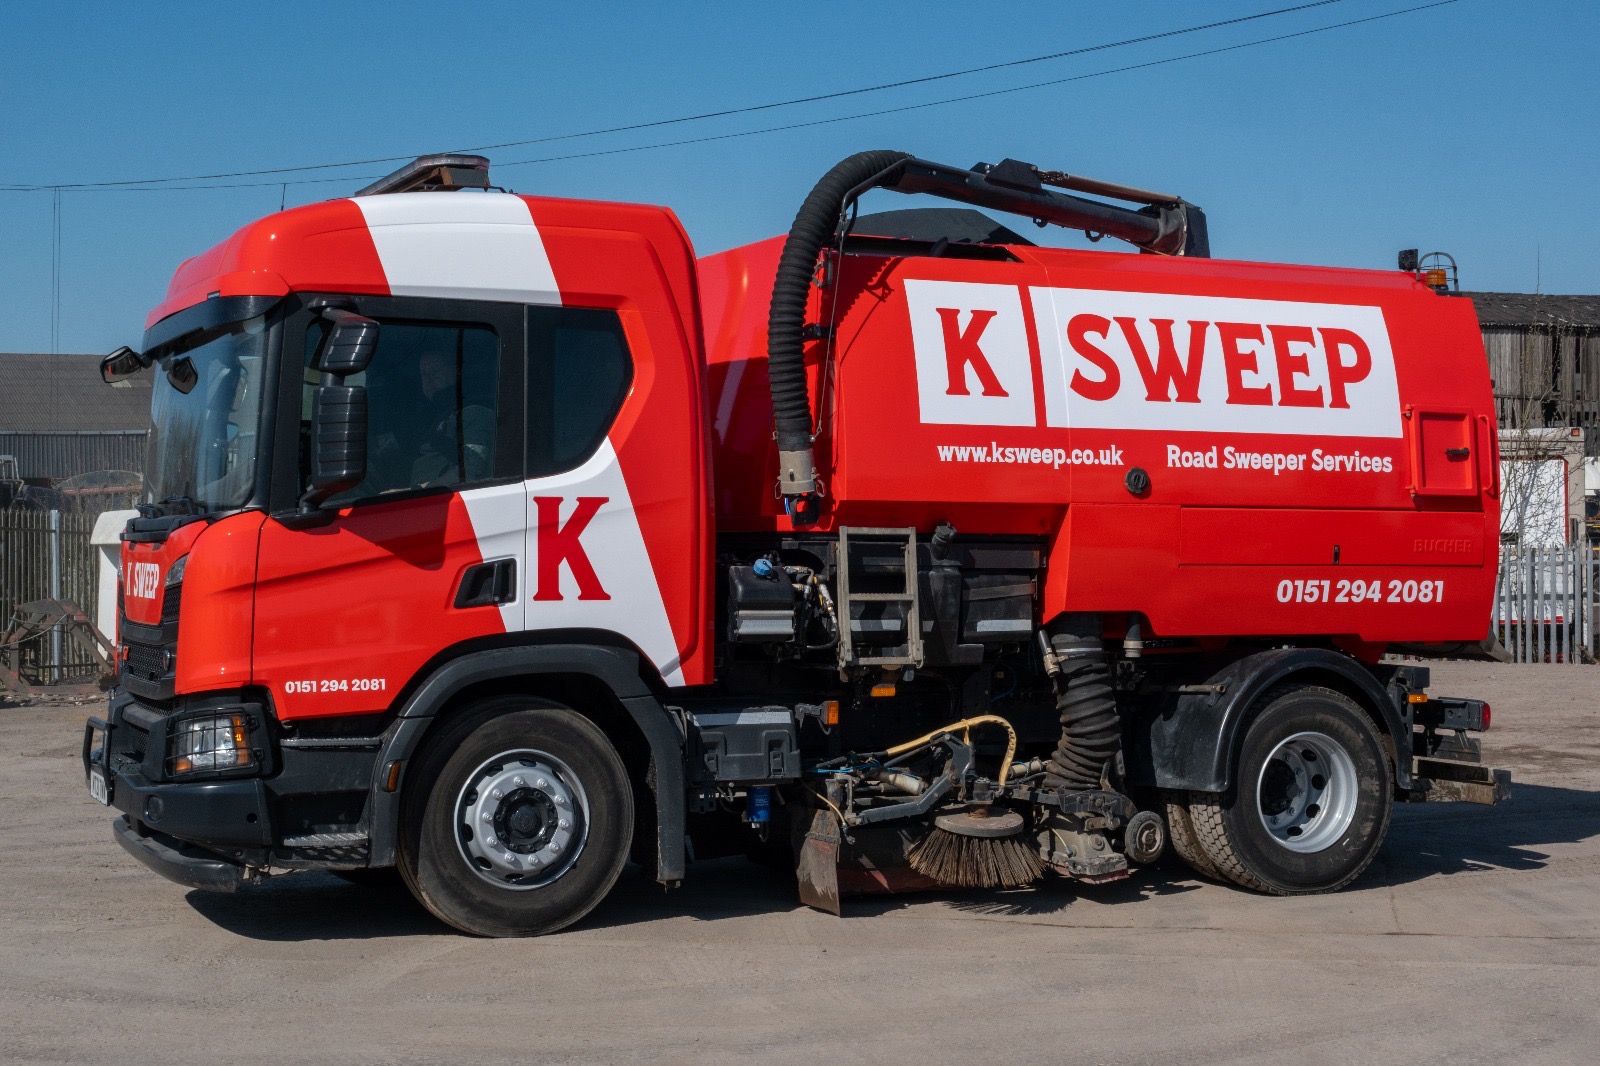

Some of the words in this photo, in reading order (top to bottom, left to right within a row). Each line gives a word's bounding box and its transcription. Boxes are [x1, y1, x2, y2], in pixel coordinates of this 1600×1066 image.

[935, 307, 1010, 398] K
[1066, 313, 1373, 410] SWEEP
[936, 441, 1125, 470] www.ksweep.co.uk
[1166, 444, 1219, 469] Road
[1222, 445, 1307, 476] Sweeper
[1311, 448, 1393, 473] Services
[532, 495, 612, 602] K
[1413, 539, 1474, 554] BUCHER
[126, 562, 132, 596] K
[133, 562, 160, 599] SWEEP
[1276, 579, 1331, 603] 0151
[1334, 579, 1382, 603] 294
[1386, 579, 1444, 603] 2081
[284, 680, 317, 694] 0151
[320, 679, 349, 693] 294
[351, 678, 386, 692] 2081
